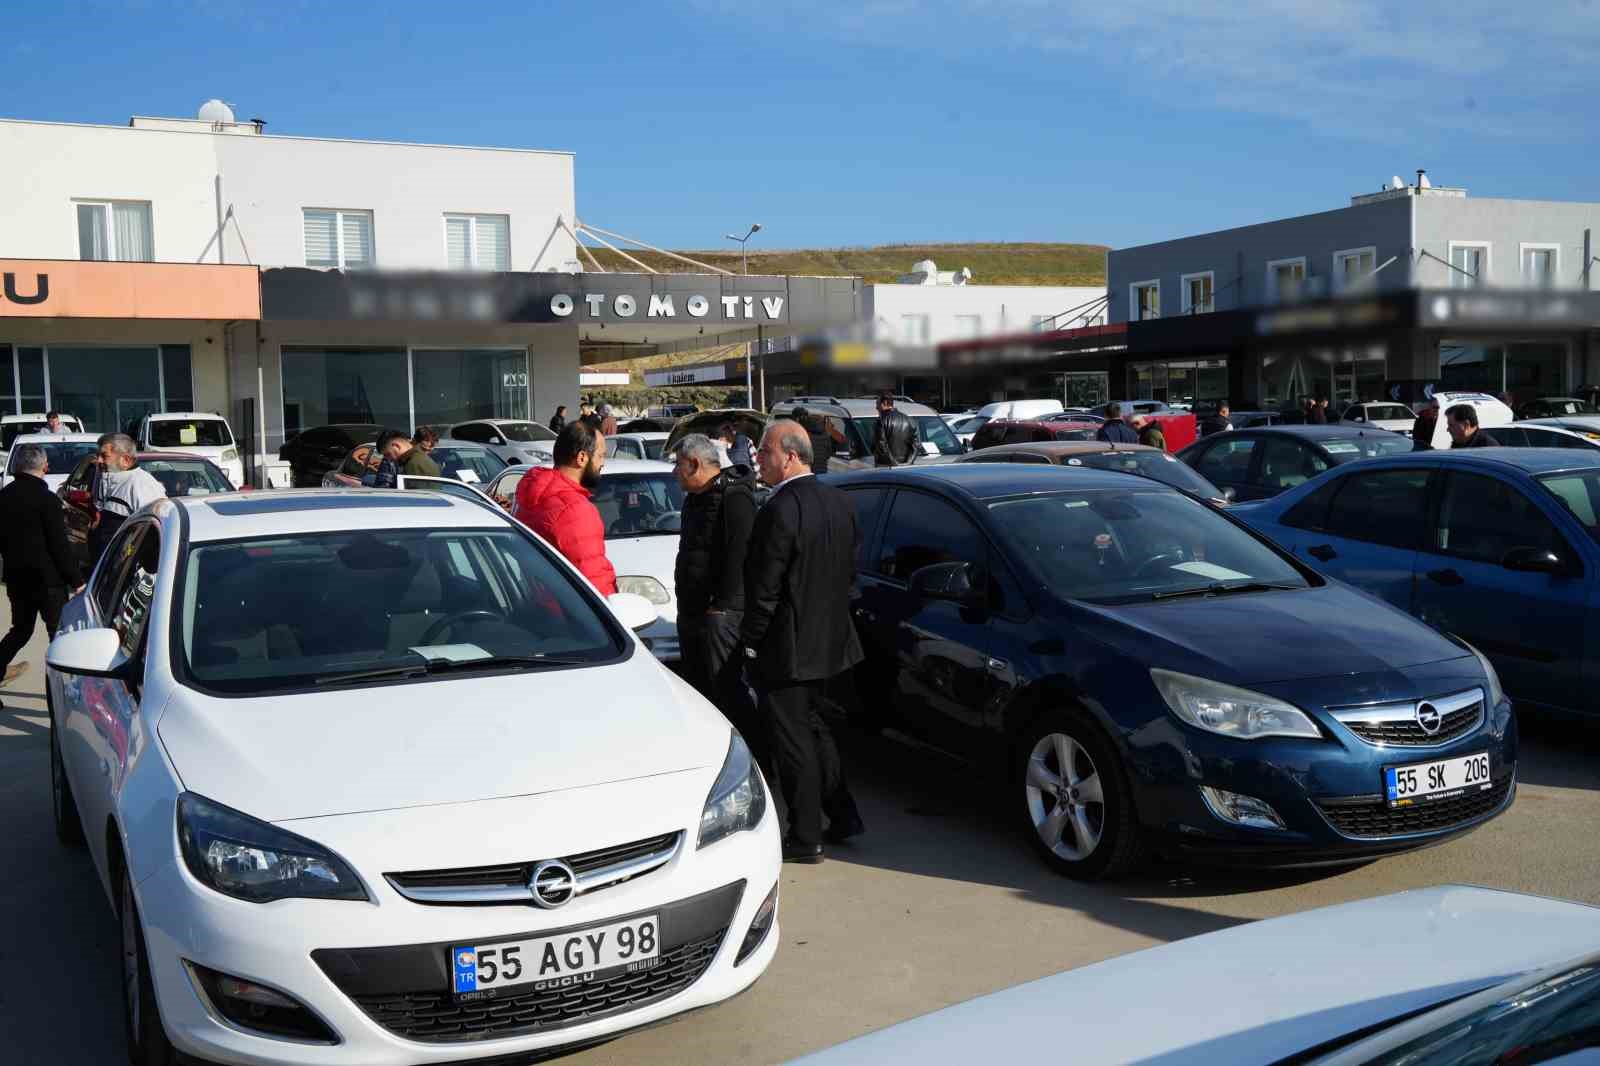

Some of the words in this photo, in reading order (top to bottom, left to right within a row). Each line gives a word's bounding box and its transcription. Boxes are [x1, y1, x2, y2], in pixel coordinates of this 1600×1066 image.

[0, 272, 49, 305] U
[1397, 769, 1417, 794] 55
[1428, 764, 1446, 789] SK
[1464, 756, 1489, 783] 206
[477, 946, 522, 984] 55
[539, 932, 606, 975] AGY
[616, 922, 656, 958] 98
[460, 972, 475, 983] TR
